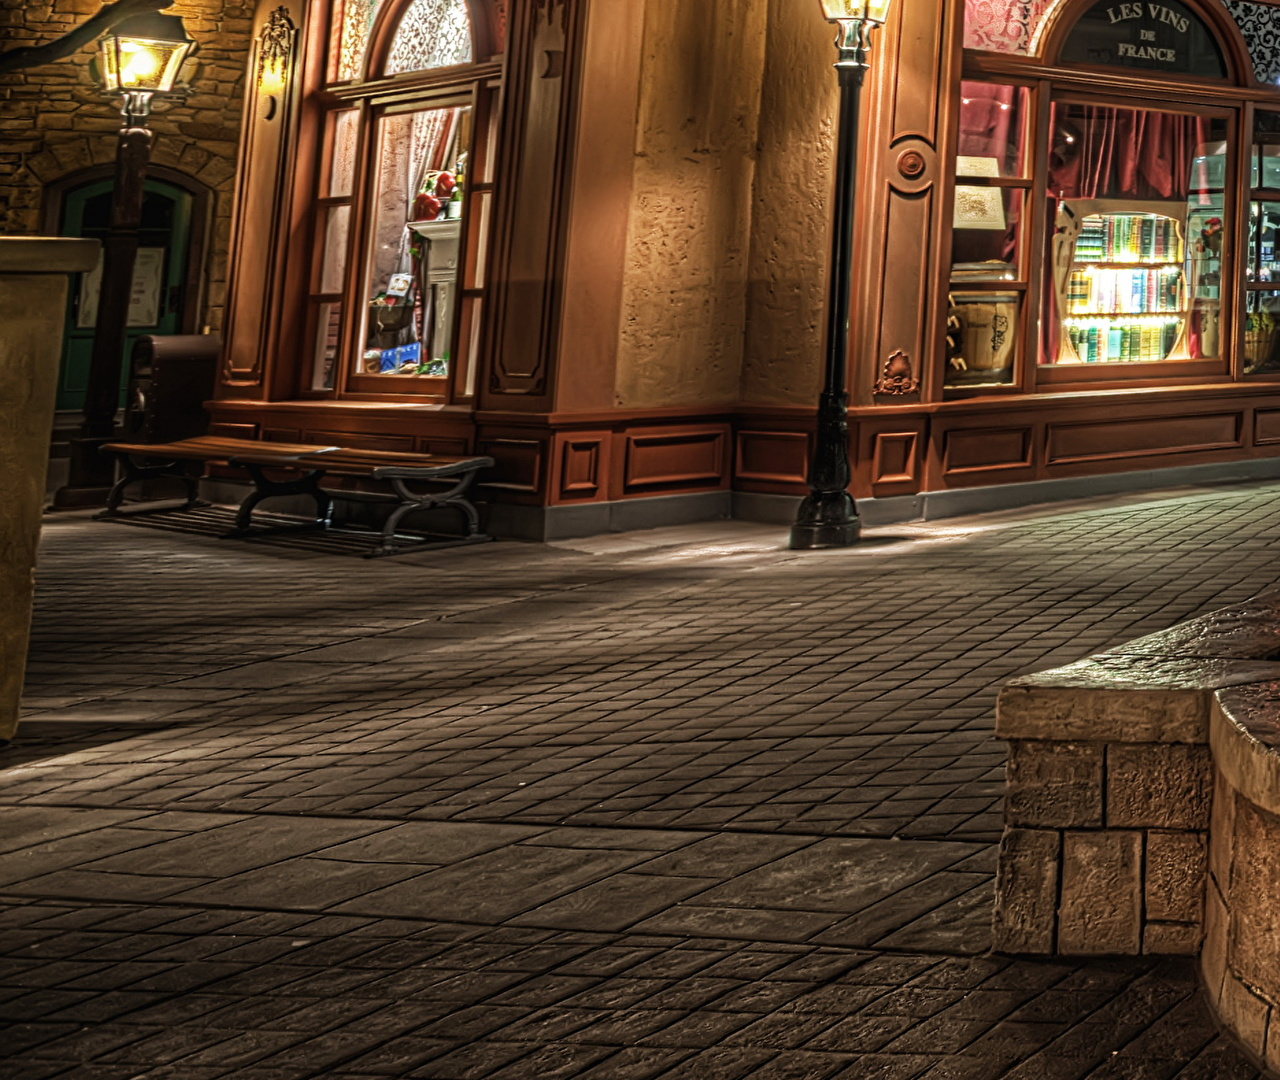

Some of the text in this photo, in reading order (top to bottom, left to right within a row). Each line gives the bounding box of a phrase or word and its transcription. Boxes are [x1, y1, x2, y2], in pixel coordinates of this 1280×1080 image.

[1107, 3, 1190, 33] LES VINS
[1140, 29, 1156, 41] DE
[1118, 43, 1176, 62] FRANCE
